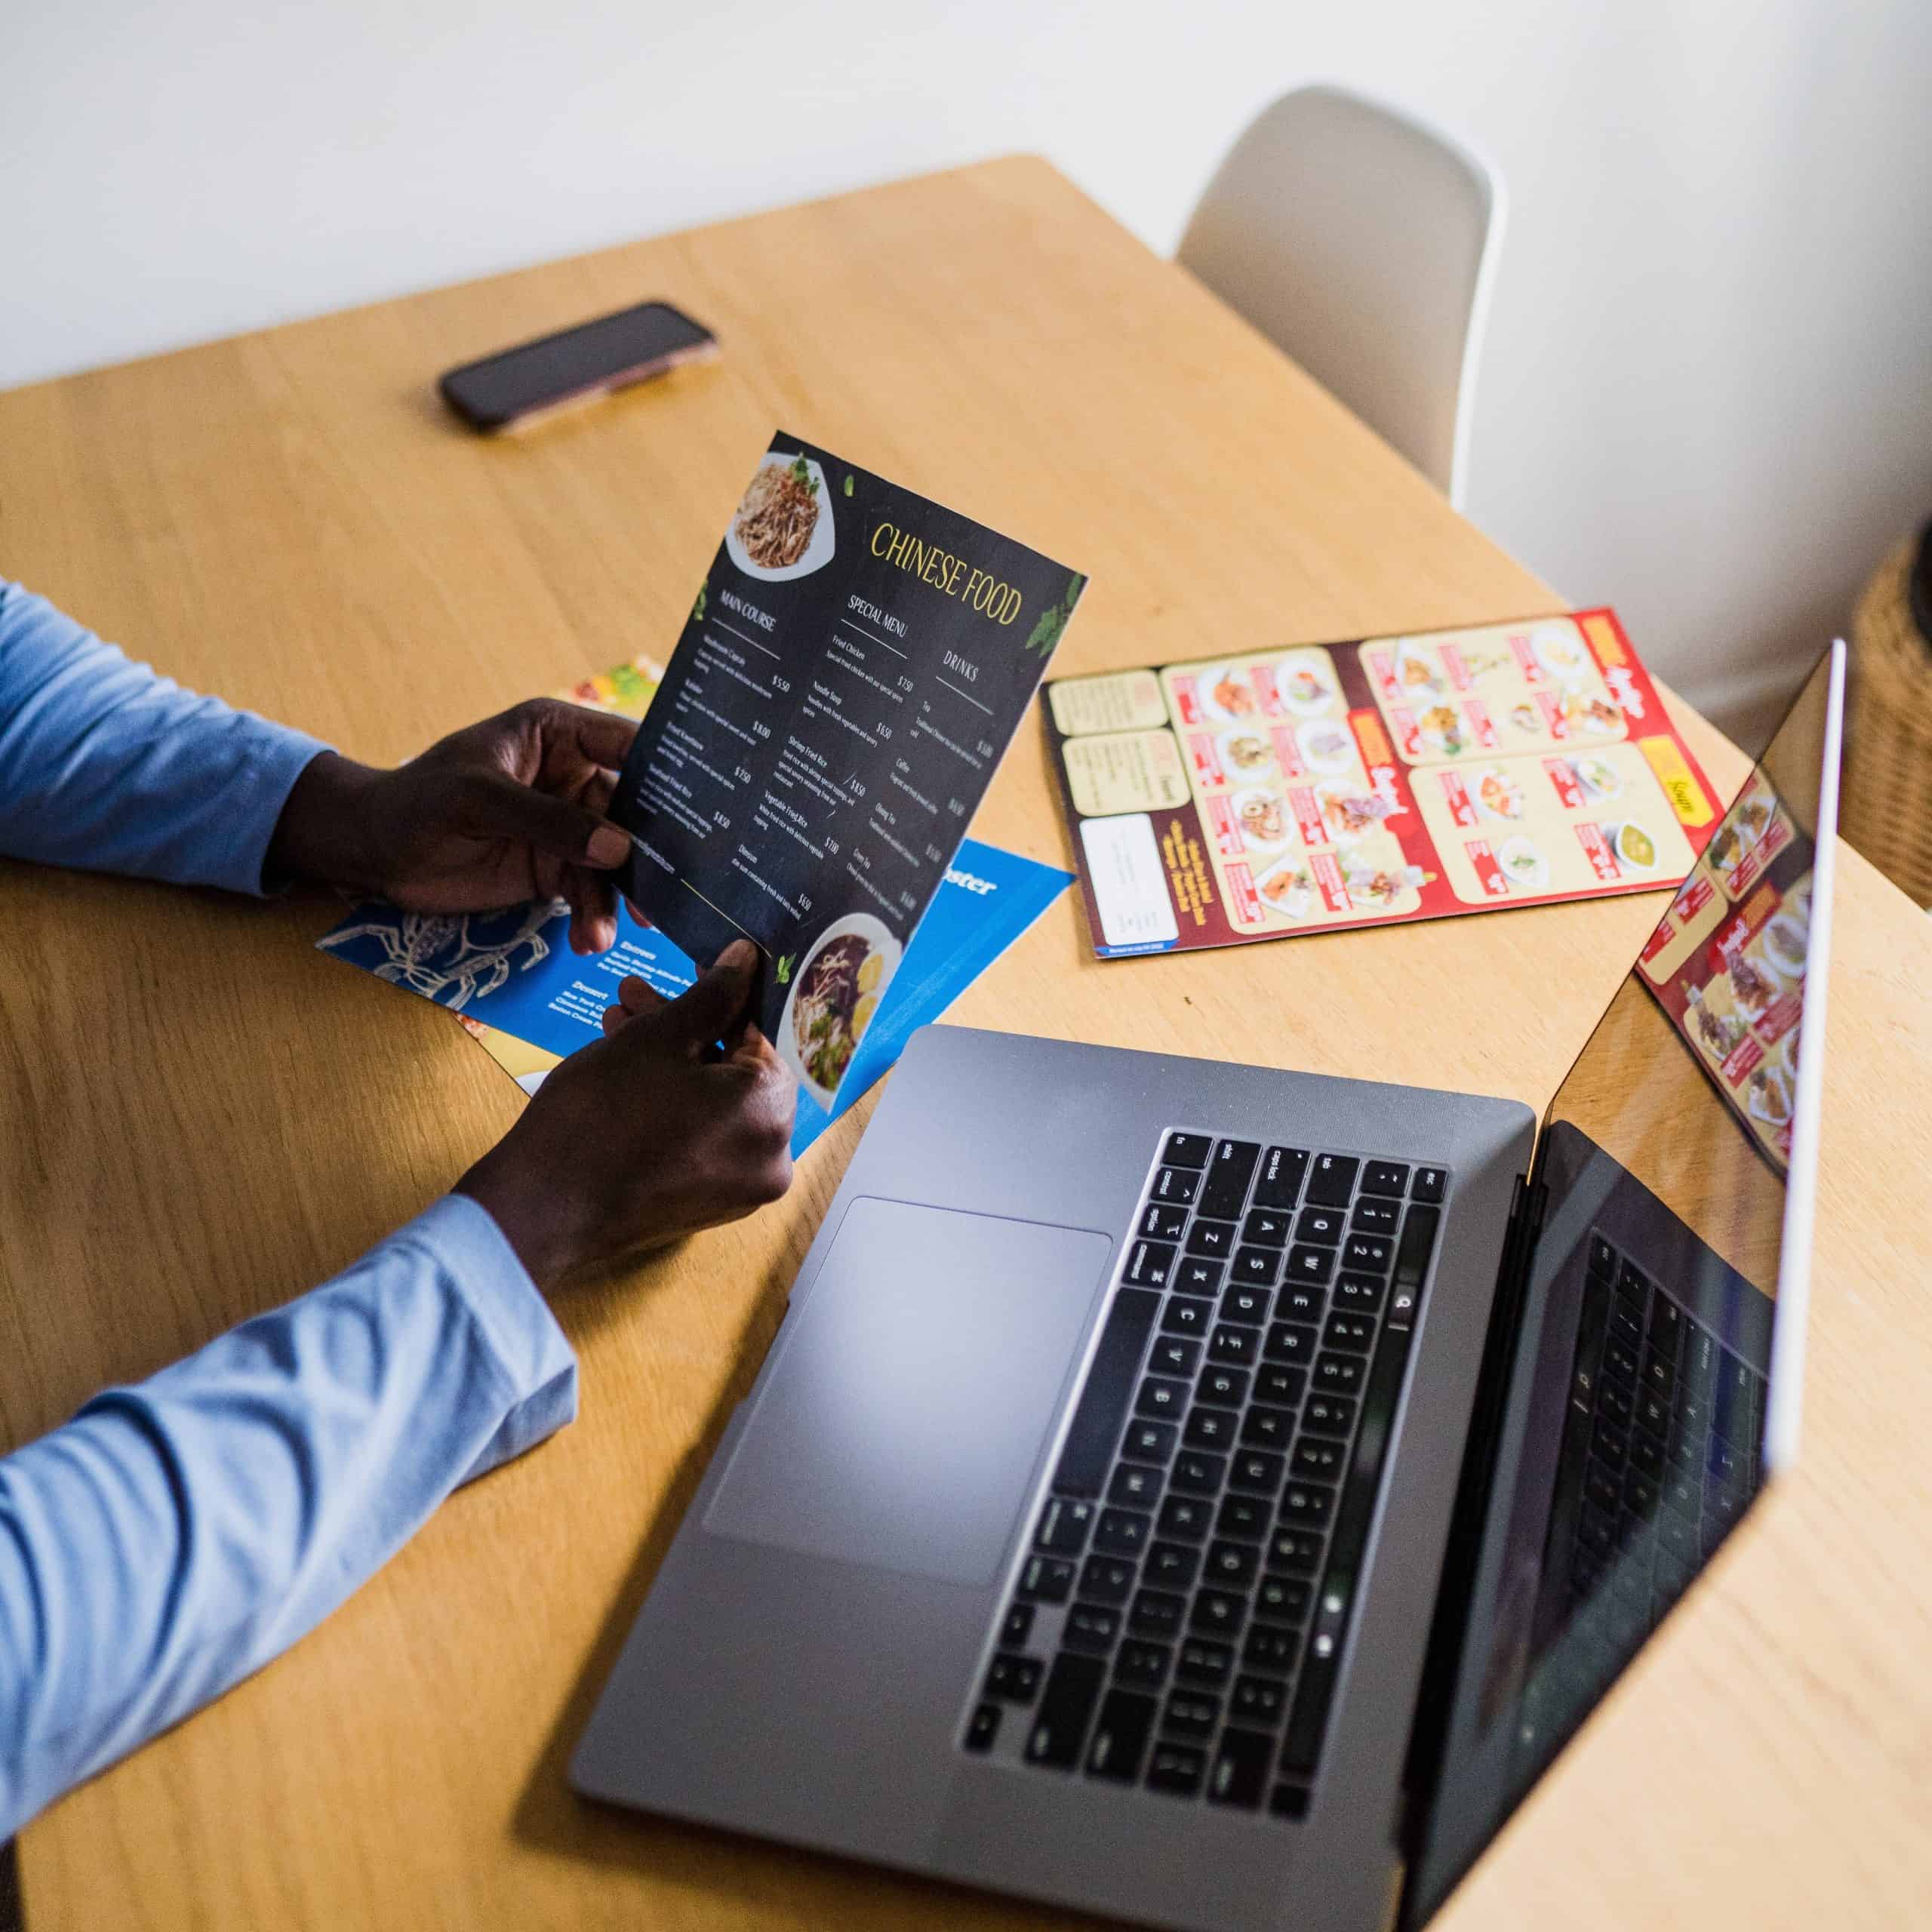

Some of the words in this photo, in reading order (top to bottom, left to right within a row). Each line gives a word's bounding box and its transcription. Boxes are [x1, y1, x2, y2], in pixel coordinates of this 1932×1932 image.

[872, 525, 966, 594] CHINESE
[963, 570, 1021, 624] FOOD
[721, 592, 741, 611] MAIN
[742, 604, 775, 631] COURSE
[848, 595, 881, 623] SPECIAL
[883, 615, 906, 637] MENU
[833, 635, 846, 648] Fried
[846, 644, 865, 660] Chicken
[943, 651, 978, 681] DRINKS
[814, 681, 829, 697] Noodle
[829, 691, 841, 705] Soup
[789, 736, 805, 752] Shrimp
[817, 755, 827, 768] Rice
[765, 791, 786, 811] Vegetable
[1222, 1144, 1232, 1159] shift
[1160, 1171, 1171, 1195] control
[1148, 1209, 1158, 1231] option
[1314, 1220, 1327, 1229] Q
[1262, 1222, 1274, 1230] A
[1205, 1233, 1218, 1242] Z
[1354, 1246, 1367, 1255] 2
[1131, 1244, 1147, 1278] command
[1251, 1260, 1263, 1269] S
[1305, 1257, 1318, 1269] W
[1194, 1270, 1207, 1281] X
[1344, 1285, 1357, 1294] 3
[1239, 1297, 1253, 1308] D
[1294, 1297, 1308, 1306] E
[1181, 1309, 1195, 1320] C
[1229, 1338, 1241, 1348] F
[1284, 1336, 1297, 1346] R
[1170, 1350, 1182, 1361] V
[1324, 1365, 1337, 1374] 5
[1274, 1380, 1287, 1389] T
[1155, 1391, 1170, 1401] B
[1262, 1421, 1275, 1431] Y
